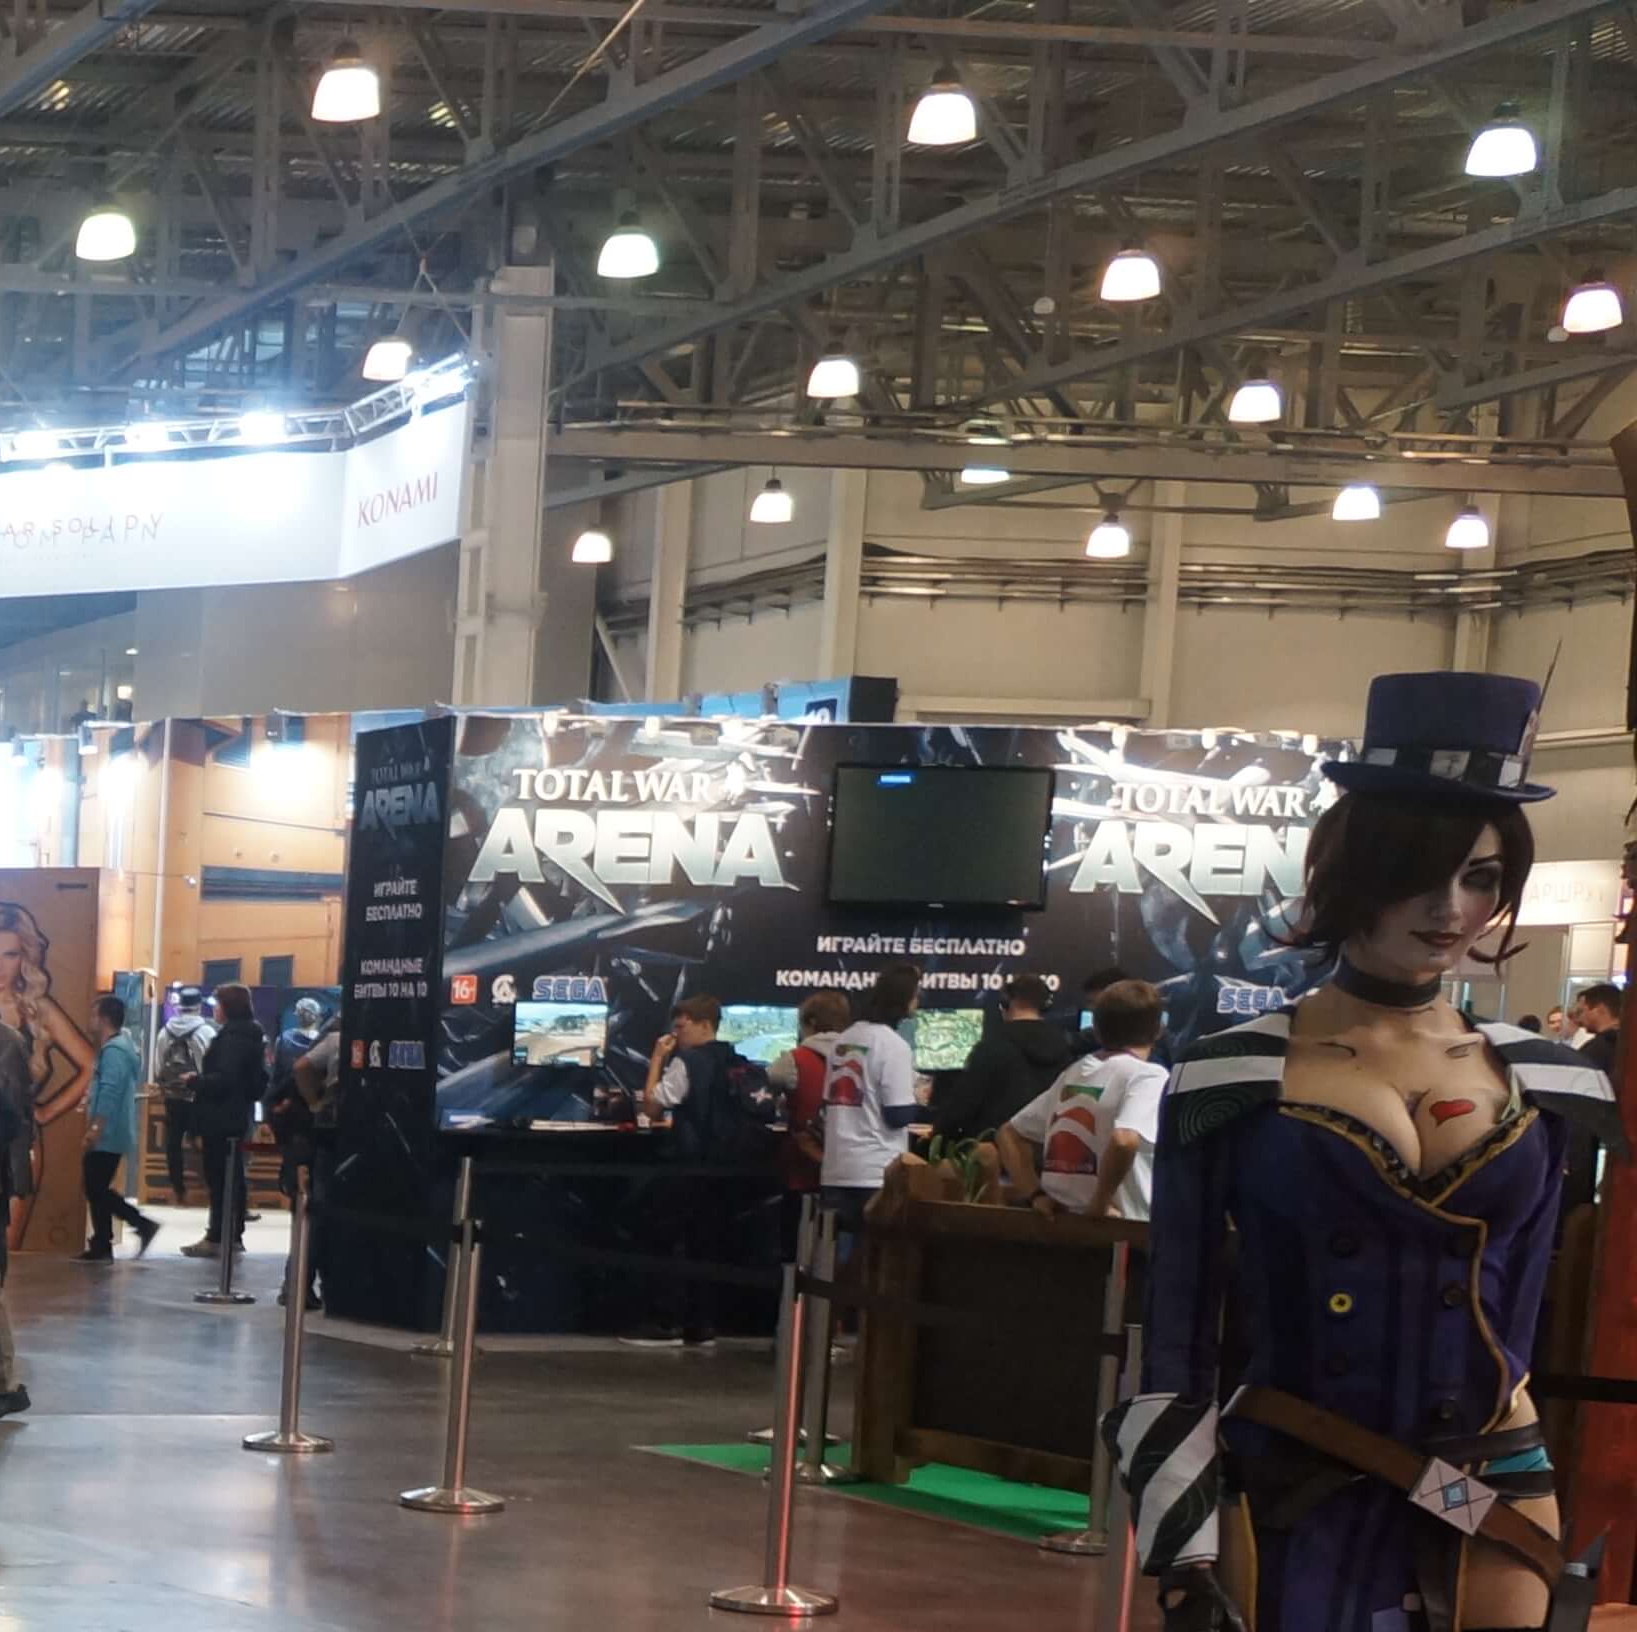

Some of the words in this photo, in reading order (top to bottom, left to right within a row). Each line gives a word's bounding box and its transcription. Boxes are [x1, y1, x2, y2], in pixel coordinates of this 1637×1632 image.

[357, 471, 438, 528] KONAMI
[512, 768, 629, 801] TOTAL
[632, 769, 713, 802] WAR
[359, 781, 441, 840] ARENA
[1116, 783, 1225, 815] TOTAL
[1231, 786, 1307, 817] WAR
[468, 808, 802, 917] ARENA
[1069, 820, 1310, 926] AREN
[373, 877, 418, 898] ИГРАЙТЕ
[365, 903, 423, 922] БЕСПЛАТНО
[816, 934, 906, 954] ИГРАЙТЕ
[909, 937, 1026, 956] БЕСПЛАТНО
[360, 957, 424, 977] КОМАНДНЫЕ
[776, 969, 879, 992] КОМАНДН
[918, 971, 977, 991] ИТВЫ
[981, 972, 1003, 991] 10
[453, 979, 477, 998] 16+
[532, 975, 609, 1002] SEGA
[1216, 985, 1285, 1015] SEGA
